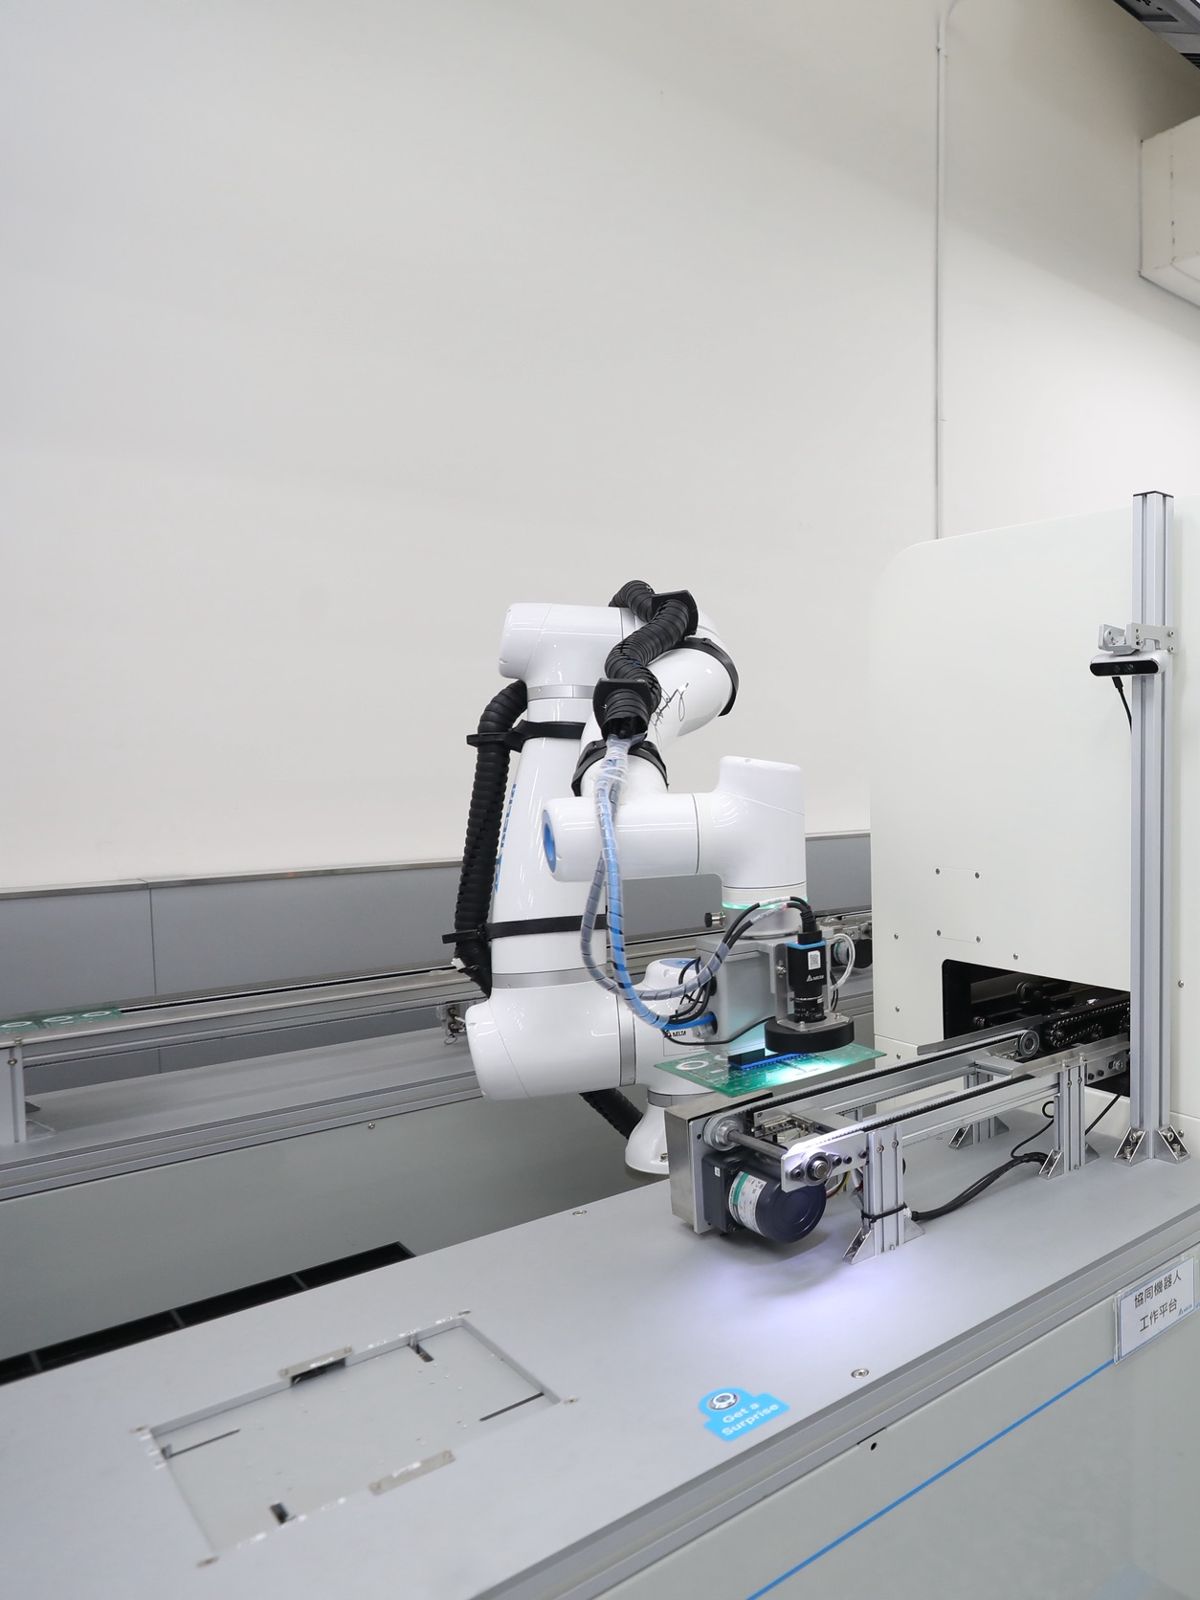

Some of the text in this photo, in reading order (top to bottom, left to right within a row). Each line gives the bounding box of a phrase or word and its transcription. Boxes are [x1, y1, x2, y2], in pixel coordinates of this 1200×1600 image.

[1134, 1269, 1182, 1309] 協同機器人
[1139, 1298, 1178, 1332] 工作平台
[721, 1404, 779, 1436] Surprise
[722, 1402, 760, 1424] Get a
